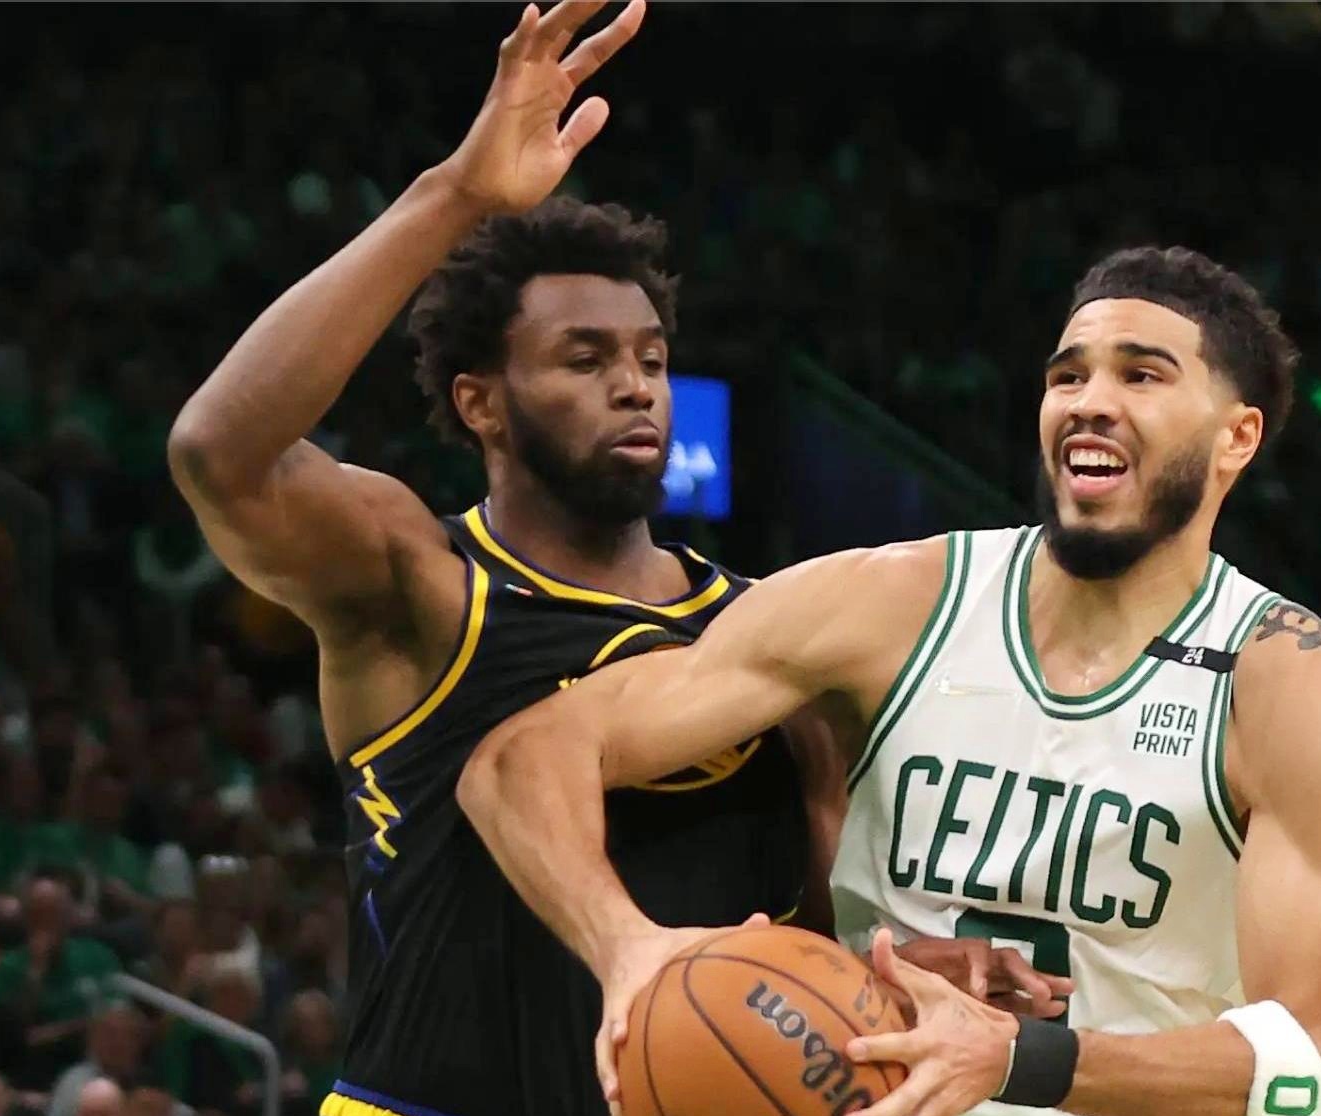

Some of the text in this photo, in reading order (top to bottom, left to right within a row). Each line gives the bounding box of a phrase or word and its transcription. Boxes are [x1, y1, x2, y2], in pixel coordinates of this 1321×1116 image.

[1181, 647, 1205, 665] 24
[1140, 702, 1199, 736] VISTA
[1133, 731, 1194, 757] PRINT
[888, 755, 1181, 929] CELTICS
[1264, 1076, 1318, 1116] 0
